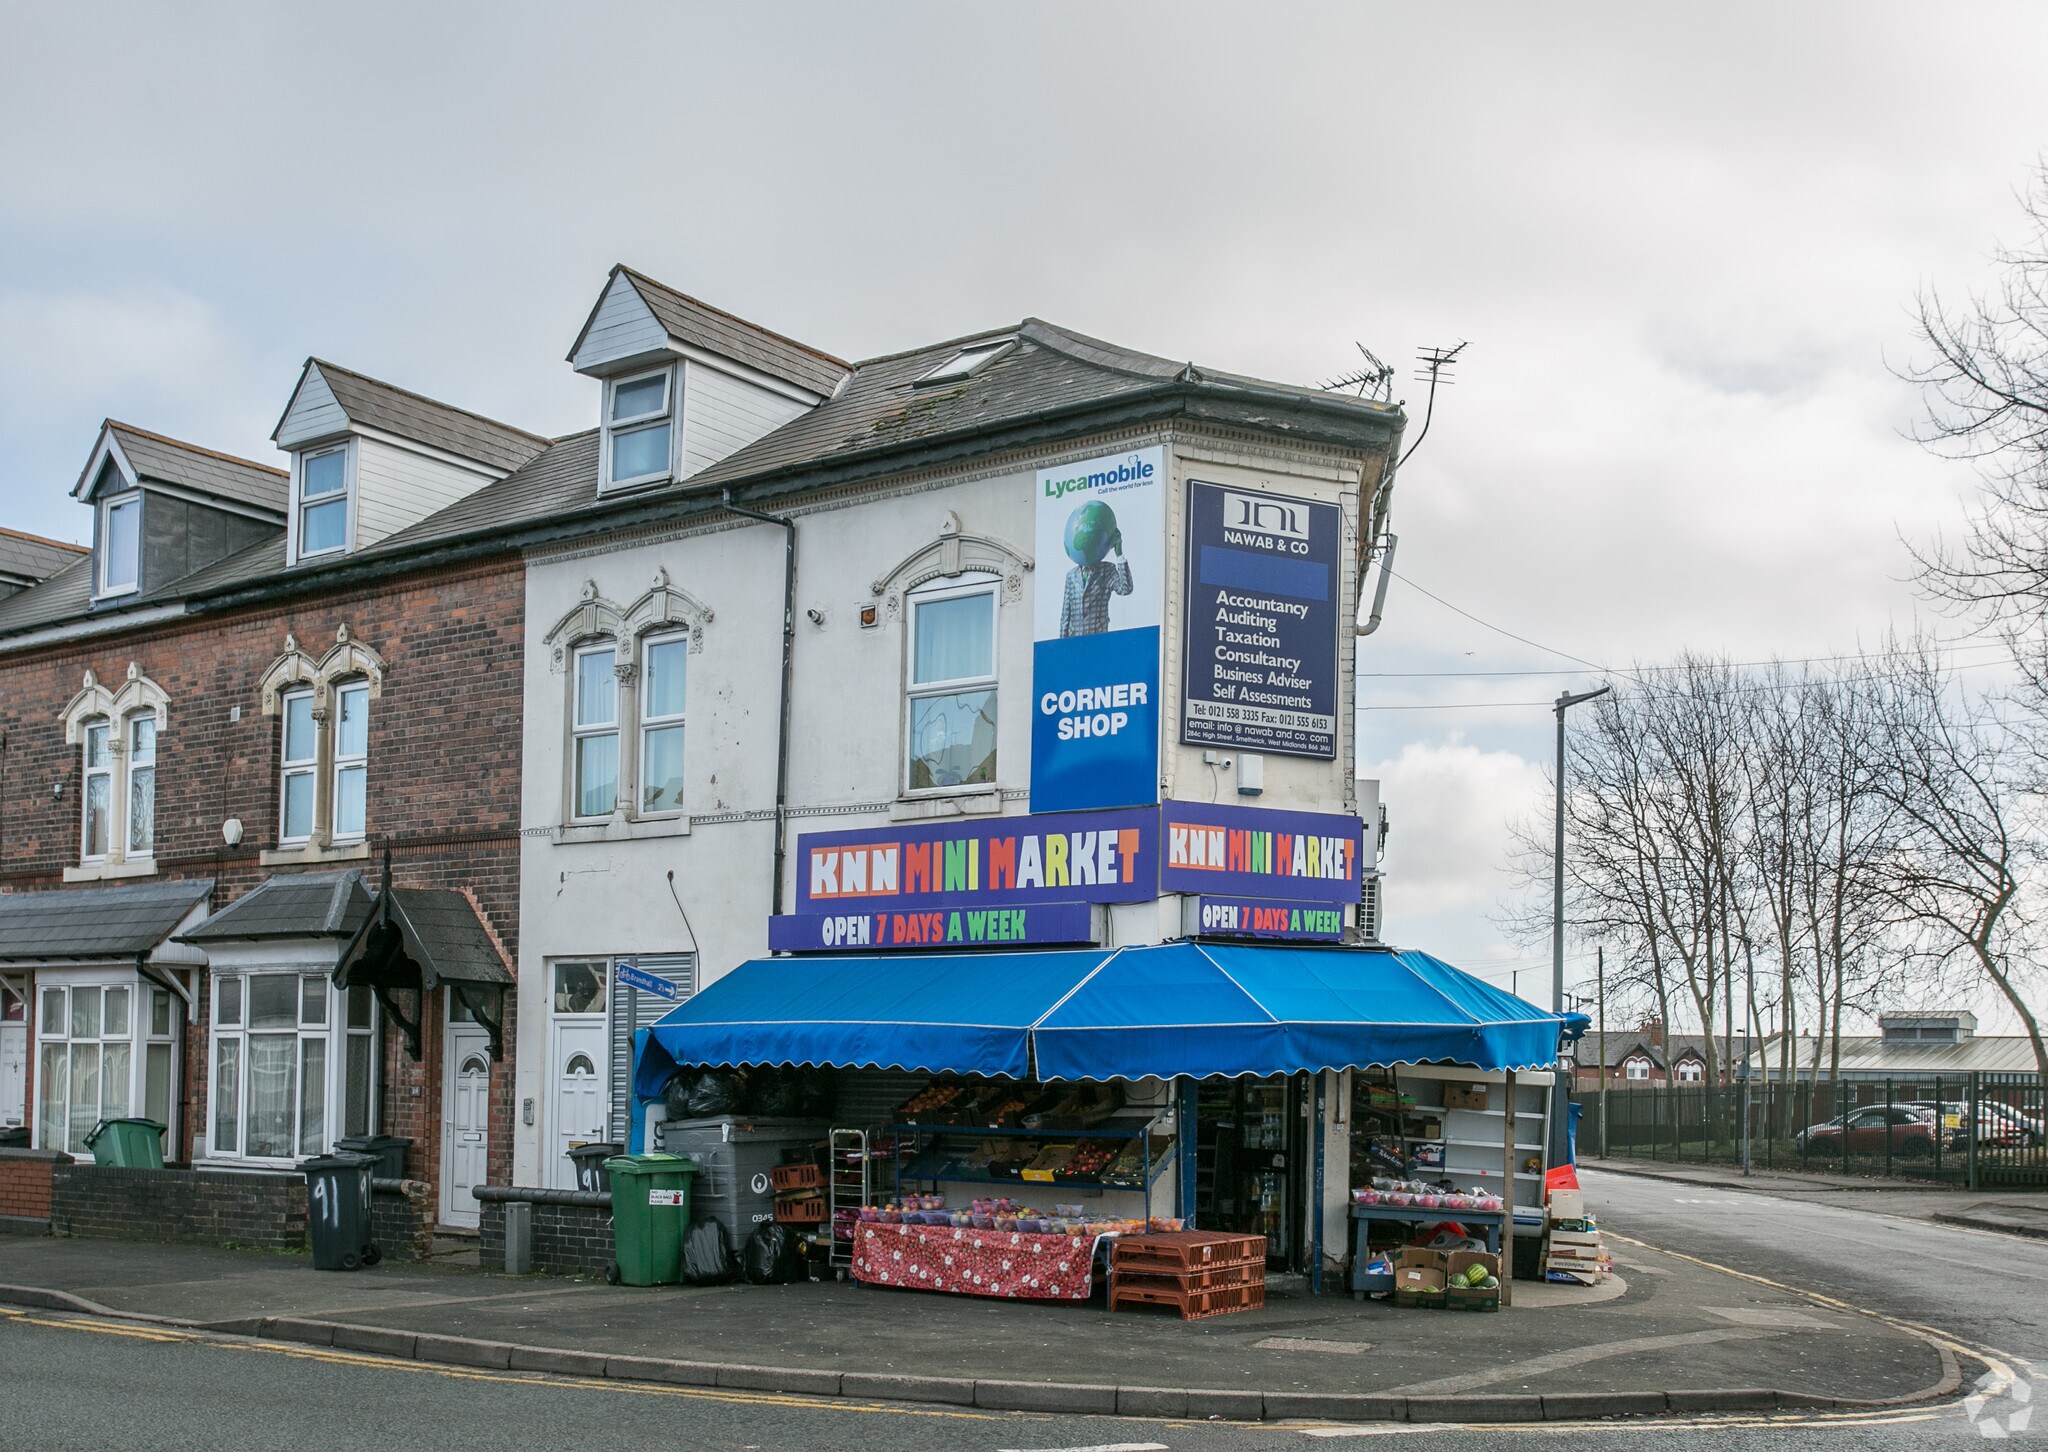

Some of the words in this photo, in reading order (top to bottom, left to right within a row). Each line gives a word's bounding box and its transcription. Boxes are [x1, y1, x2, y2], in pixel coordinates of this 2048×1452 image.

[1045, 457, 1154, 498] Lycamobile
[1119, 483, 1134, 491] world
[1224, 530, 1274, 549] NAWAB
[1277, 539, 1286, 552] &
[1290, 541, 1309, 555] CO
[1216, 590, 1309, 619] Accountancy
[1215, 607, 1277, 632] Auditing
[1215, 626, 1280, 648] Taxation
[1215, 645, 1301, 674] Consultancy
[1214, 664, 1263, 684] Business
[1266, 671, 1312, 690] Adviser
[1041, 682, 1148, 715] CORNER
[1213, 683, 1236, 699] Self
[1239, 686, 1312, 709] Assessments
[1057, 712, 1128, 740] SHOP
[1193, 704, 1206, 715] Tel:
[1208, 705, 1225, 718] 0121
[1226, 707, 1239, 719] 558
[1242, 709, 1259, 721] 3335
[1261, 711, 1277, 724] Fax:
[1279, 714, 1295, 726] 0121
[1296, 716, 1309, 727] 555
[1311, 718, 1327, 729] 6153
[1189, 719, 1215, 730] email:
[1217, 721, 1232, 732] info
[1235, 724, 1242, 734] @
[1245, 726, 1273, 737] nawab
[1275, 730, 1292, 739] and
[1294, 733, 1307, 741] co.
[1310, 734, 1328, 743] com
[1202, 732, 1215, 740] High
[1281, 740, 1307, 749] Midlands
[810, 847, 898, 895] KNN
[905, 838, 979, 894] MINI
[989, 828, 1140, 890] MARKET
[1169, 826, 1225, 868] KNN
[1228, 828, 1272, 874] MINI
[1276, 832, 1355, 881] MARKET
[821, 915, 870, 946] OPEN
[875, 914, 888, 944] 7
[893, 912, 944, 944] DAYS
[946, 911, 963, 943] A
[967, 909, 1026, 942] WEEK
[1202, 904, 1238, 929] OPEN
[1242, 907, 1250, 929] 7
[1254, 906, 1289, 932] DAYS
[1290, 909, 1301, 932] A
[1303, 910, 1341, 934] WEEK
[630, 973, 653, 988] Brandhall
[582, 1168, 600, 1193] 91
[314, 1176, 338, 1228] 91
[752, 1213, 773, 1223] 0345
